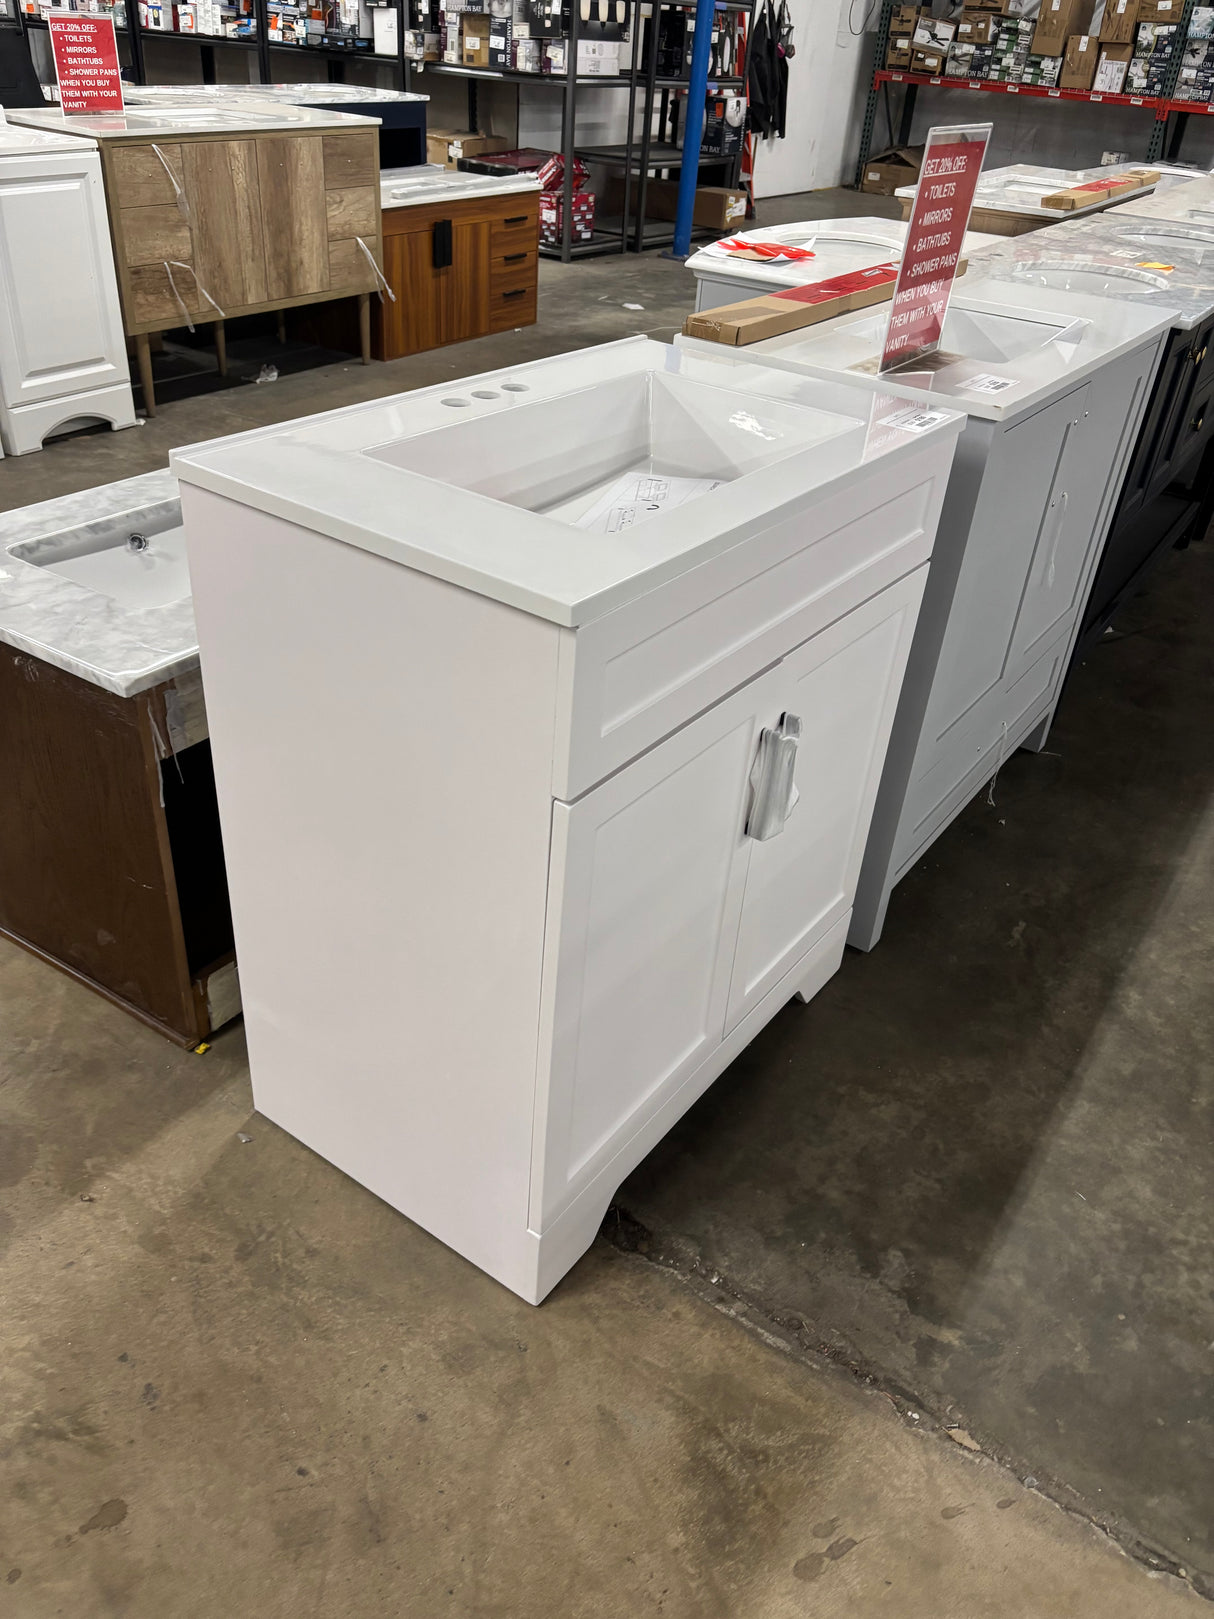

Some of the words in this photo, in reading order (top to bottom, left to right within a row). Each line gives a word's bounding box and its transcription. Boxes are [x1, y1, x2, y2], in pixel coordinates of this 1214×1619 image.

[51, 23, 65, 31] GET
[81, 24, 97, 32] OFF:
[924, 158, 940, 175] GET
[939, 157, 953, 173] 20%
[953, 155, 968, 171] OFF:
[929, 182, 956, 200] TOILETS
[922, 207, 953, 226] MIRRORS
[916, 231, 952, 252] BATHTUBS
[911, 259, 940, 277] SHOWER
[940, 252, 958, 269] PANS
[895, 288, 915, 305] WHEN
[916, 283, 930, 299] YOU
[930, 278, 945, 294] BUY
[891, 312, 909, 329] THEM
[909, 307, 925, 323] WITH
[926, 300, 944, 316] YOUR
[885, 334, 909, 354] VANITY
